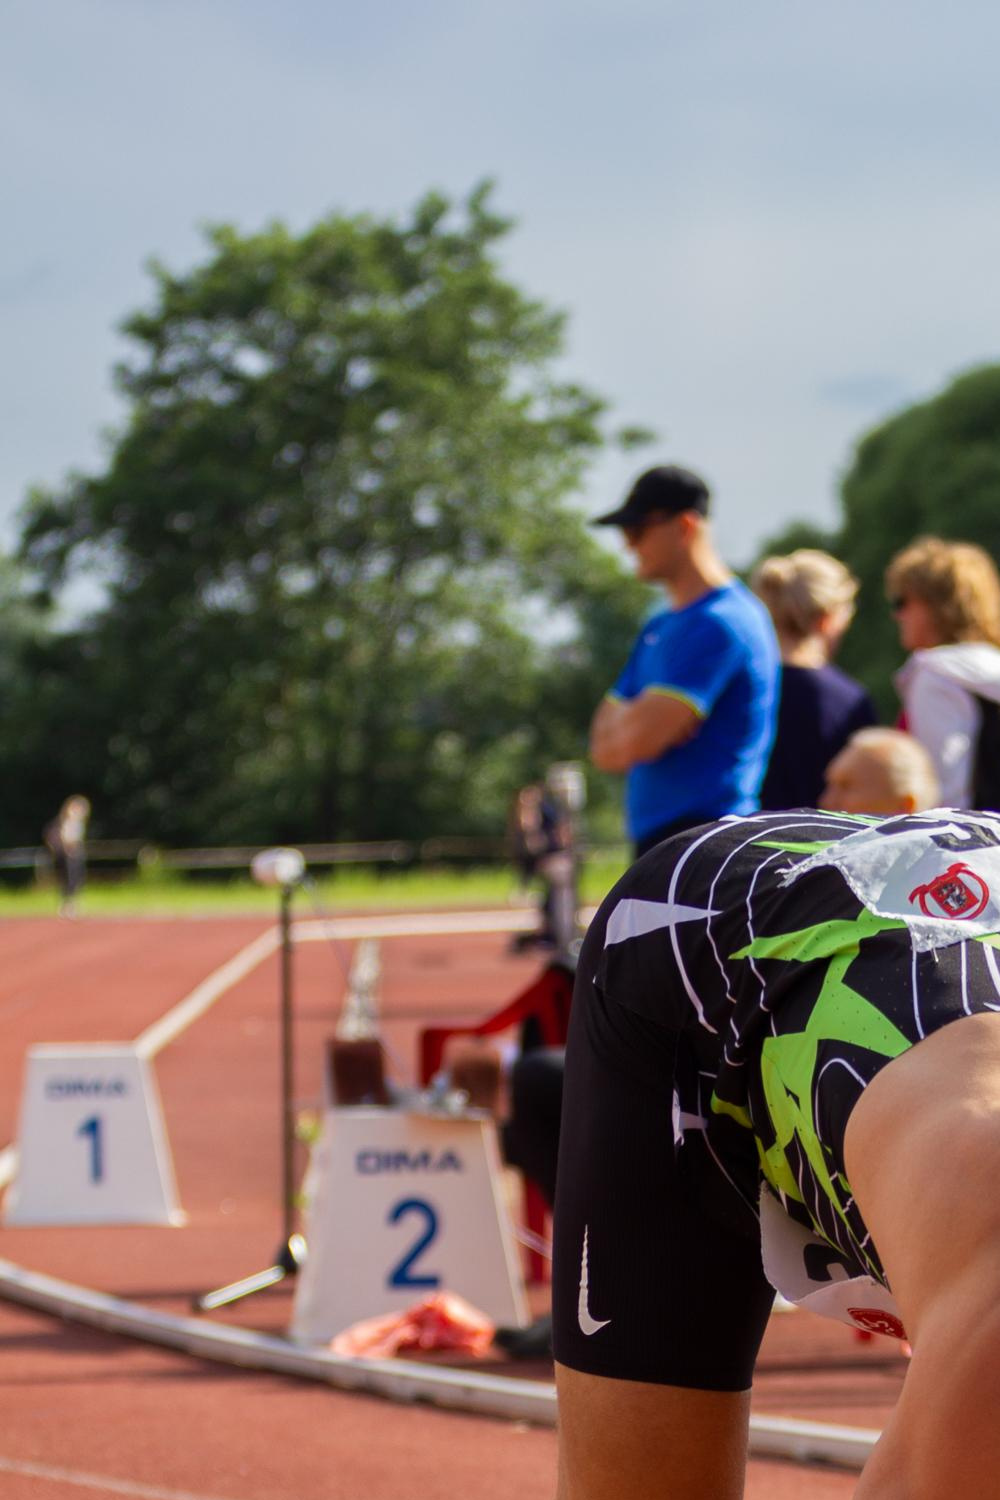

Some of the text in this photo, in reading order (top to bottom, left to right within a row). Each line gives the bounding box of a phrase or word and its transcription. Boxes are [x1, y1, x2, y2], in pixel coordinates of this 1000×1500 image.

[77, 1115, 104, 1184] 1
[355, 1149, 463, 1174] DIMA
[387, 1197, 441, 1288] 2
